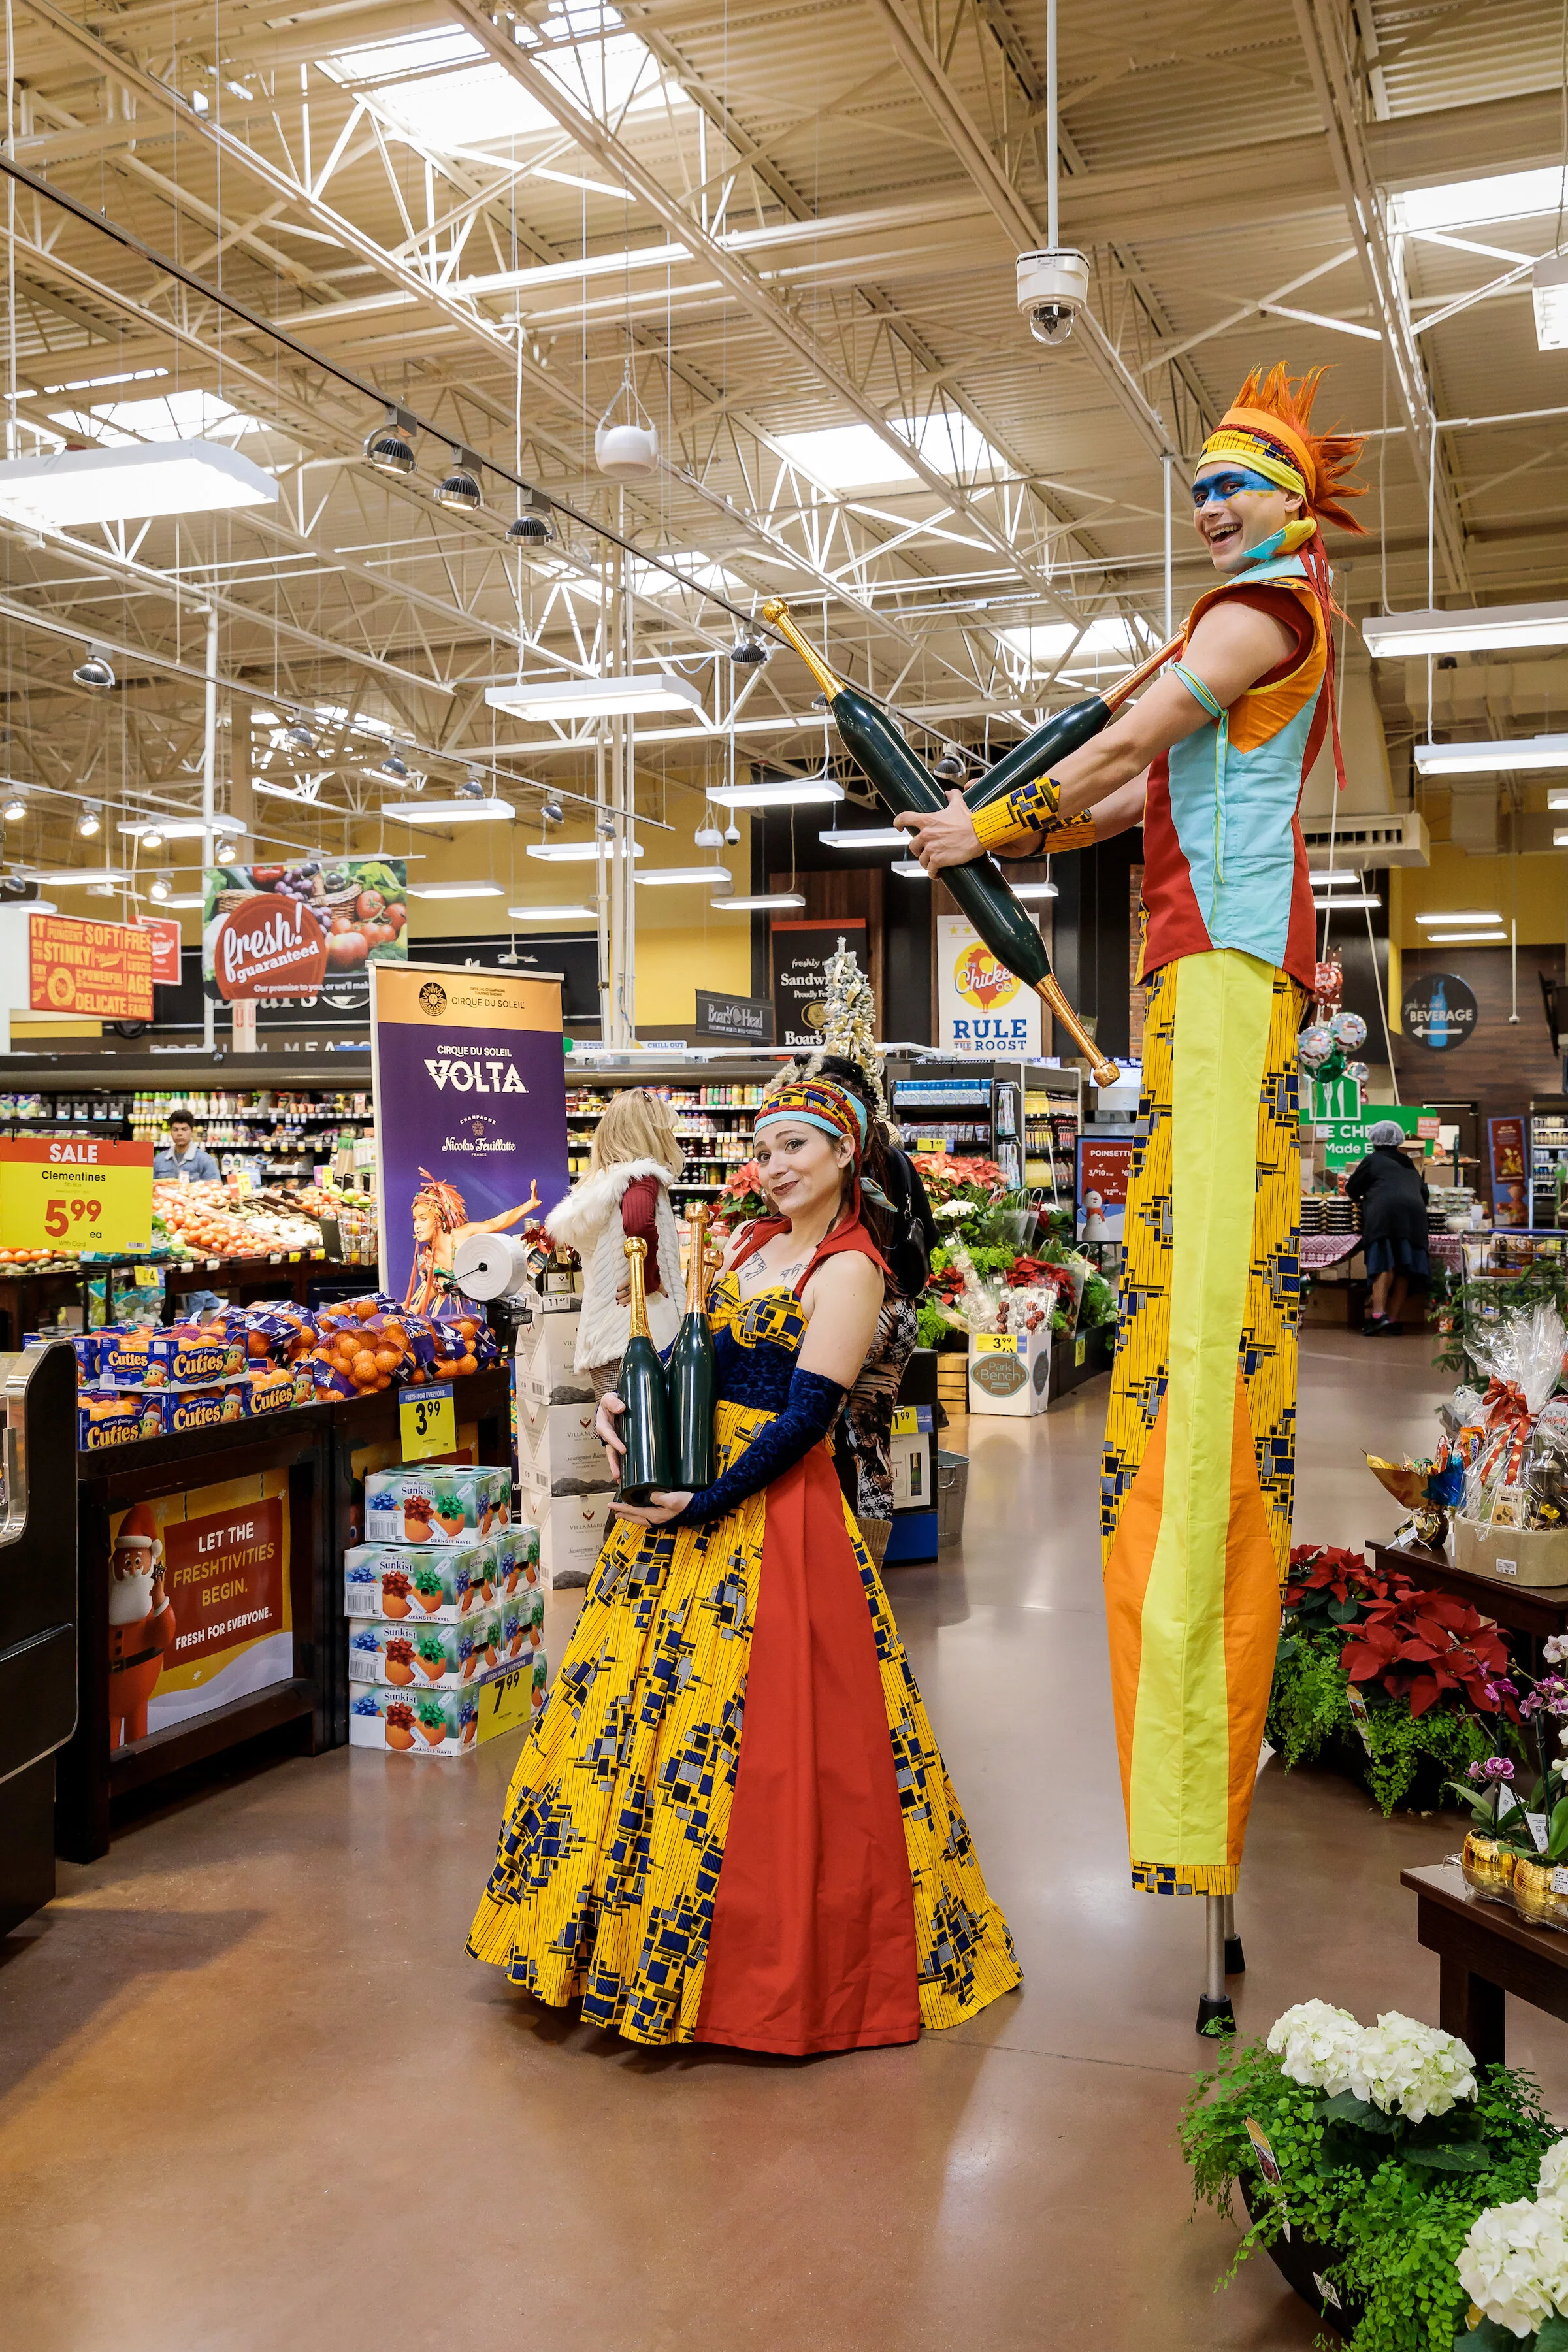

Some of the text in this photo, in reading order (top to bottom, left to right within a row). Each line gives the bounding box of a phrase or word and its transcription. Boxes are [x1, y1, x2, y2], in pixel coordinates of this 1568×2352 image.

[85, 924, 120, 947] SOFT
[223, 901, 303, 983] fresh!
[43, 940, 91, 966] STINKY
[236, 940, 320, 984] guaranteed
[792, 958, 820, 969] freshly
[781, 973, 829, 986] Sandwi
[955, 961, 1013, 994] Chicke
[253, 984, 269, 992] Our
[794, 990, 817, 1000] Proudly
[75, 991, 127, 1015] DELICATE
[451, 997, 482, 1008] CIRQUE
[498, 1000, 525, 1009] SOLEIL
[708, 1004, 763, 1029] Boar's Head
[1410, 1009, 1473, 1022] BEVERAGE
[953, 1019, 1027, 1039] RULE
[785, 1030, 823, 1045] Boar's
[437, 1045, 512, 1057] CIRQUE DU SOLEIL
[975, 1040, 1026, 1051] ROOST
[424, 1059, 529, 1094] VOLTA
[459, 1115, 497, 1125] CHAMPAGNE
[1340, 1124, 1373, 1139] CHE
[441, 1137, 516, 1152] Nicolas Feuillatte
[1325, 1143, 1360, 1154] Made
[49, 1143, 98, 1164] SALE
[42, 1170, 106, 1182] Clementines
[108, 1350, 148, 1367] Cuties
[173, 1354, 223, 1377] Cuties
[989, 1362, 1011, 1371] Park
[981, 1369, 1021, 1381] Bench
[250, 1387, 293, 1414] Cuties
[173, 1405, 221, 1431] Cuties
[87, 1424, 139, 1449] Cuties
[402, 1486, 434, 1497] Sunkist
[199, 1521, 254, 1553] LET THE
[173, 1542, 274, 1588] FRESHTIVITIES
[380, 1561, 413, 1572] Sunkist
[202, 1577, 248, 1607] BEGIN.
[176, 1629, 204, 1650] FRESH
[208, 1622, 225, 1640] FOR
[384, 1627, 416, 1639] Sunkist
[485, 1672, 498, 1683] FRESH
[498, 1669, 506, 1678] FOR
[384, 1692, 416, 1704] Sunkist
